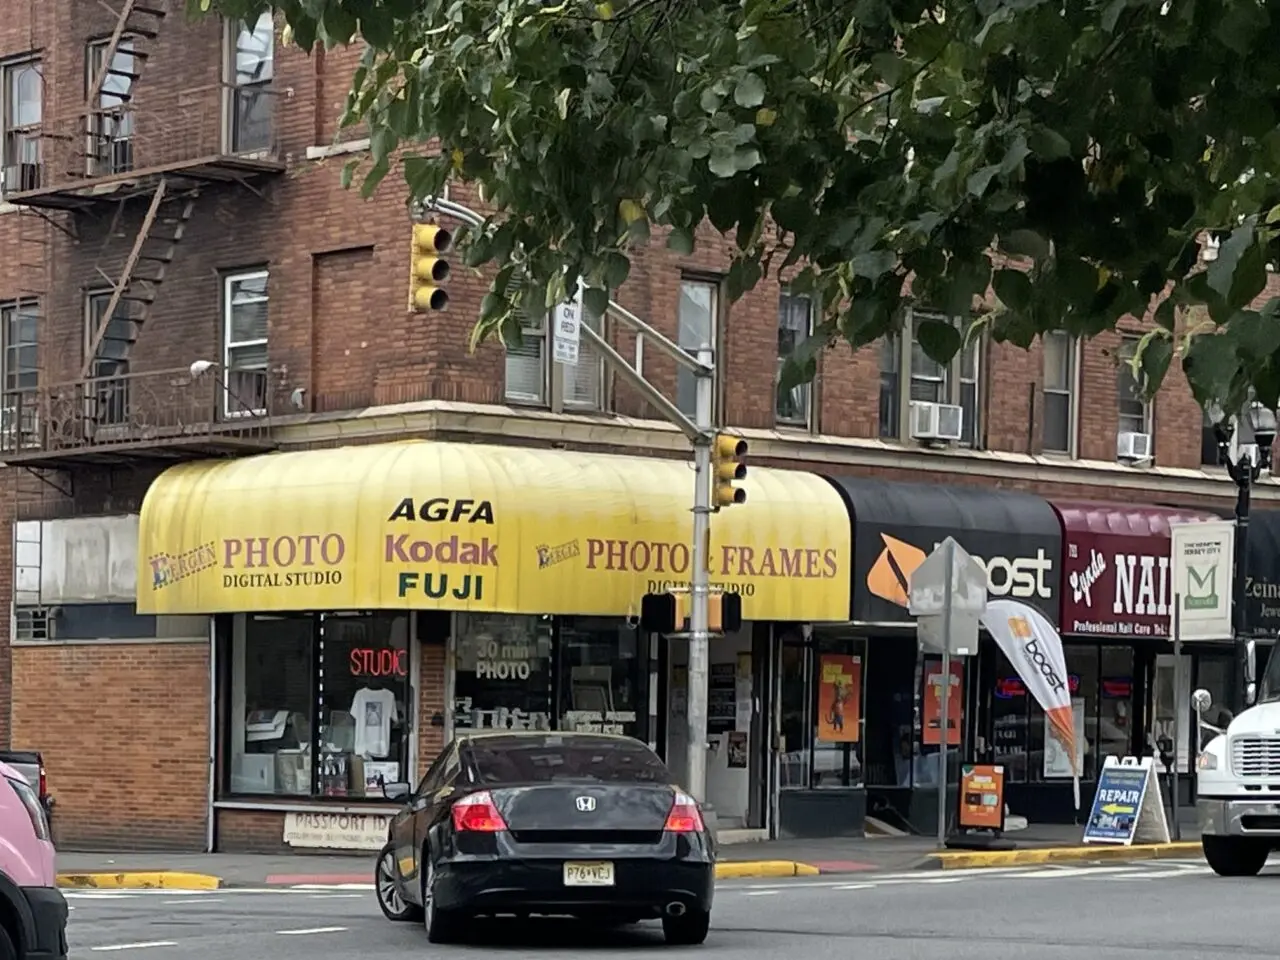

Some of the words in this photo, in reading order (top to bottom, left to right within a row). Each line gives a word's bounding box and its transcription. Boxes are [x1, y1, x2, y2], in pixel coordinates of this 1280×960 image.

[387, 498, 494, 524] AGFA
[149, 544, 217, 587] BERGEN
[223, 533, 345, 568] PHOTO
[385, 534, 499, 567] Kodak
[586, 539, 690, 573] PHOTO
[721, 545, 838, 578] FRAMES
[223, 572, 283, 588] DIGITAL
[285, 570, 342, 586] STUDIO
[398, 572, 483, 601] FUJI
[1113, 554, 1172, 615] NAI
[476, 641, 498, 659] 30
[476, 661, 531, 680] PHOTO
[1024, 639, 1066, 694] boost
[1099, 789, 1140, 803] REPAIR
[295, 813, 367, 831] PASSPORT
